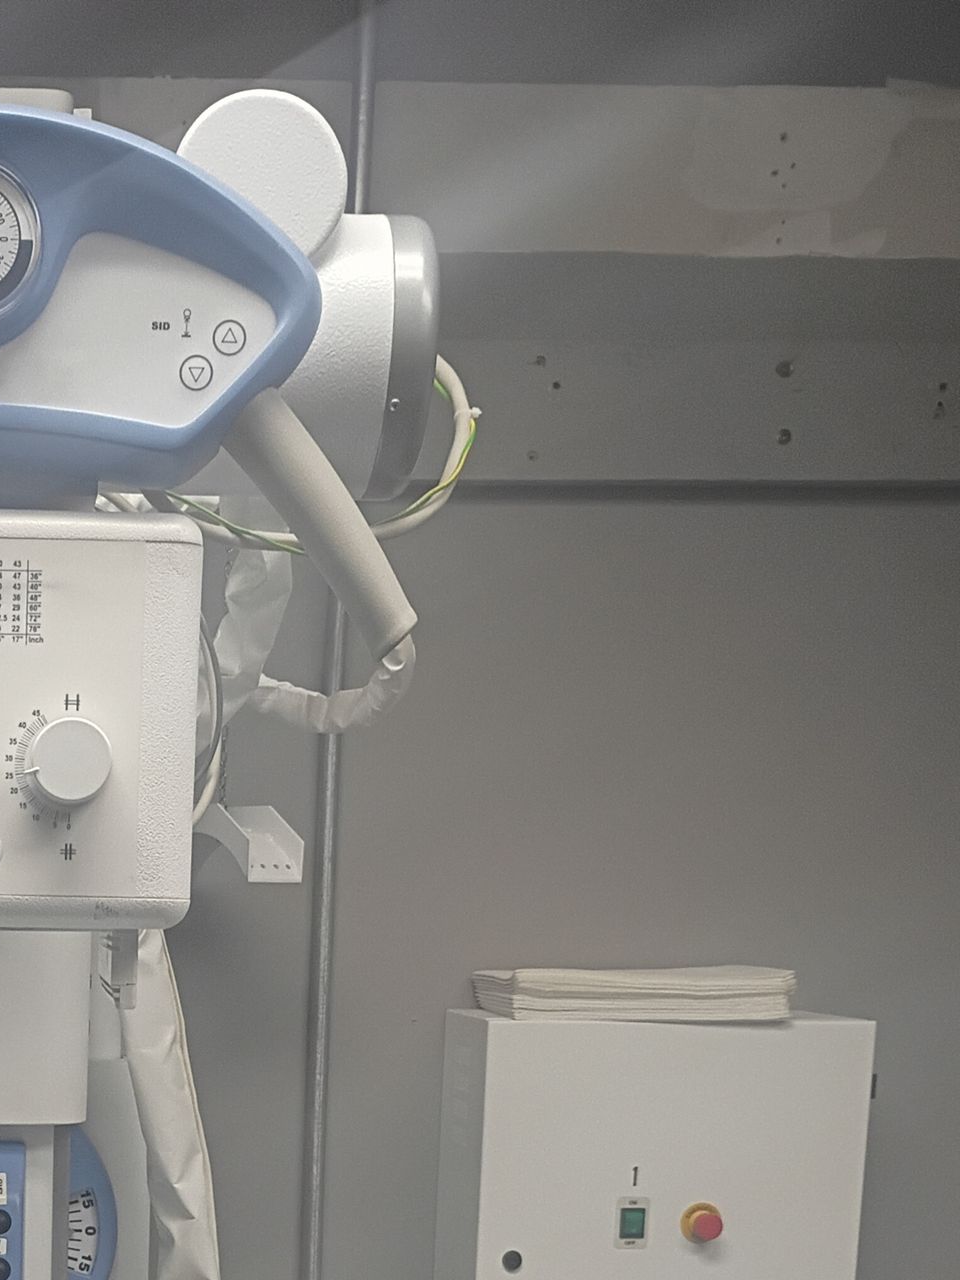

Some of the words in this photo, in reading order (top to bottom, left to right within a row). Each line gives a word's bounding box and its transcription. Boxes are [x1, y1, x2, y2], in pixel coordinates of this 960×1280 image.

[151, 321, 171, 331] SID
[13, 560, 22, 568] 43
[13, 572, 21, 580] 47
[12, 614, 21, 622] 24
[32, 709, 41, 717] 45
[5, 772, 14, 780] 25
[19, 802, 27, 810] 15
[81, 1191, 94, 1209] 15
[85, 1226, 96, 1236] 0
[79, 1255, 92, 1272] 15
